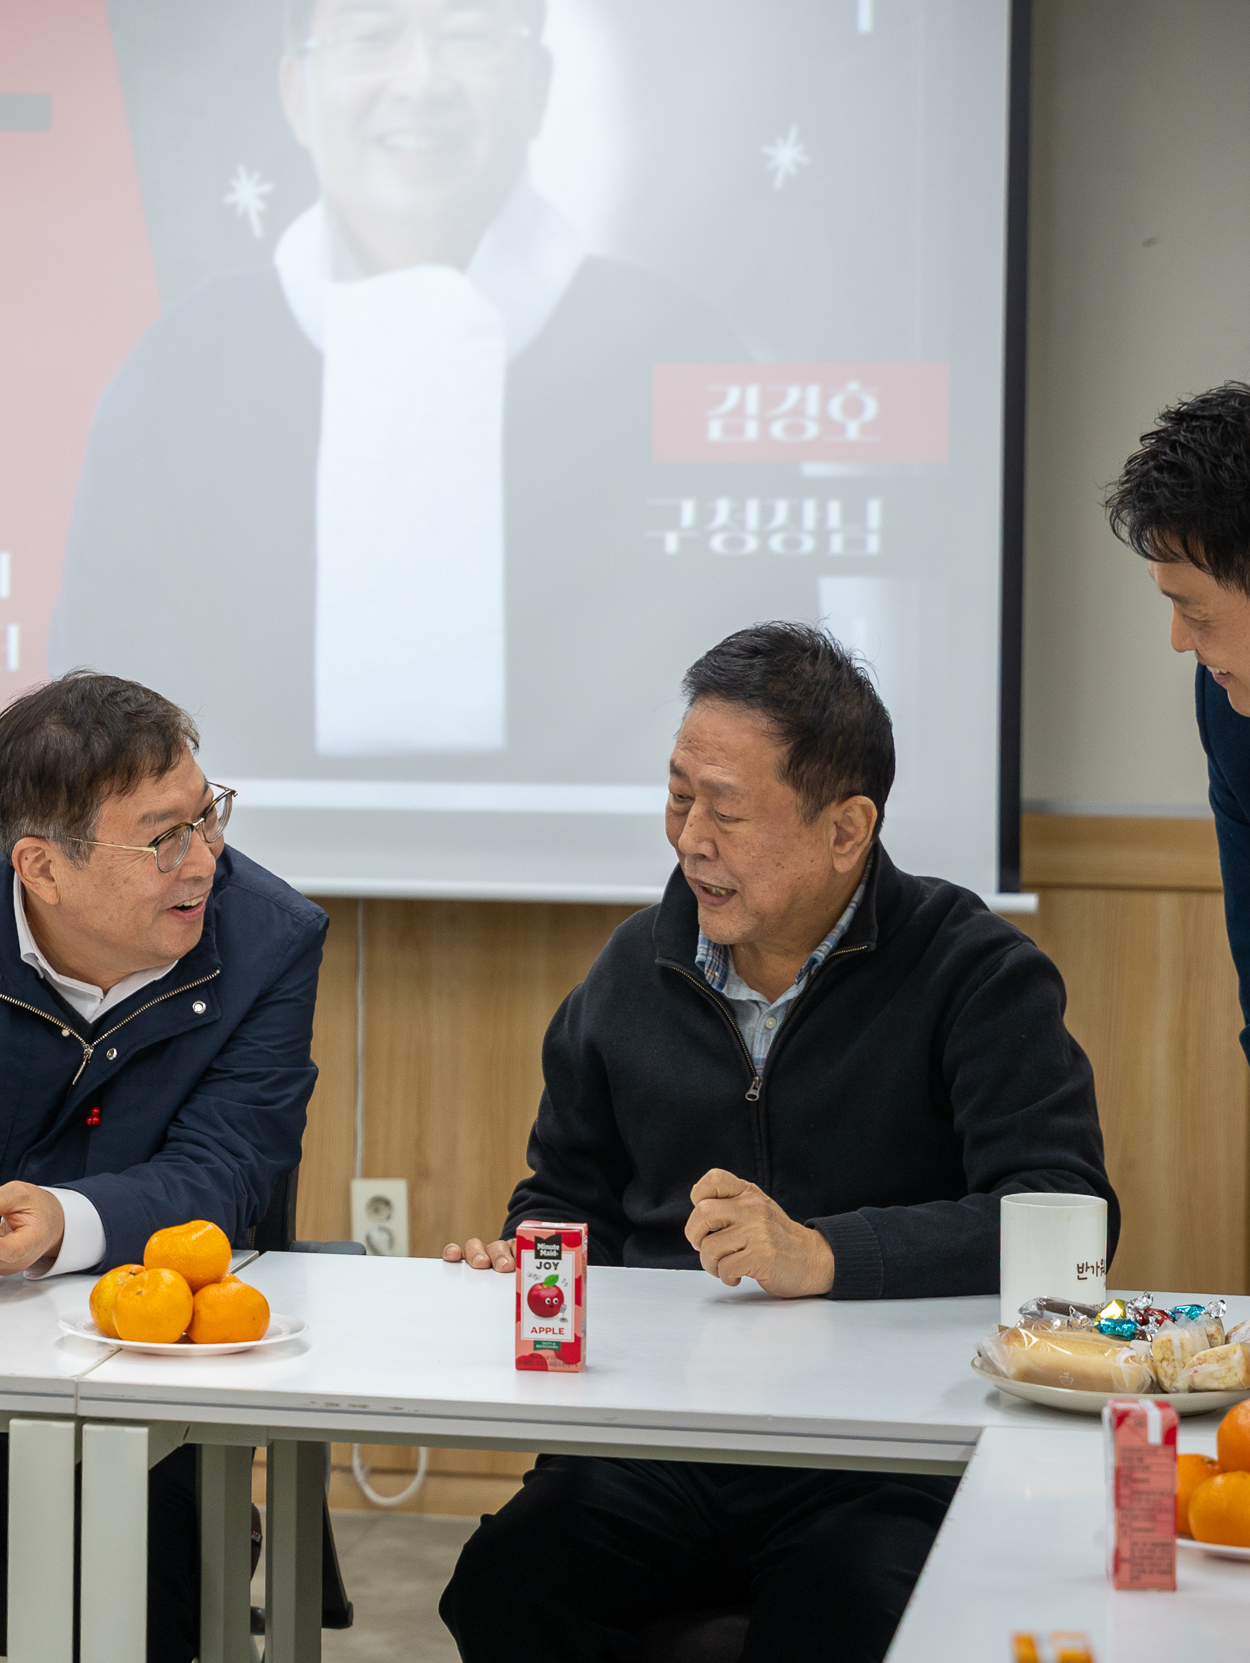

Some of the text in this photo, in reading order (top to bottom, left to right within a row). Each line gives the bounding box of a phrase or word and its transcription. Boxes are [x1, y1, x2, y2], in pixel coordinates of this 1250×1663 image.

[704, 381, 881, 443] 김경호
[643, 497, 883, 556] 구청장님
[536, 1242, 560, 1251] Minute
[539, 1249, 559, 1257] Maid
[535, 1261, 560, 1271] JOY
[530, 1326, 565, 1335] APPLE
